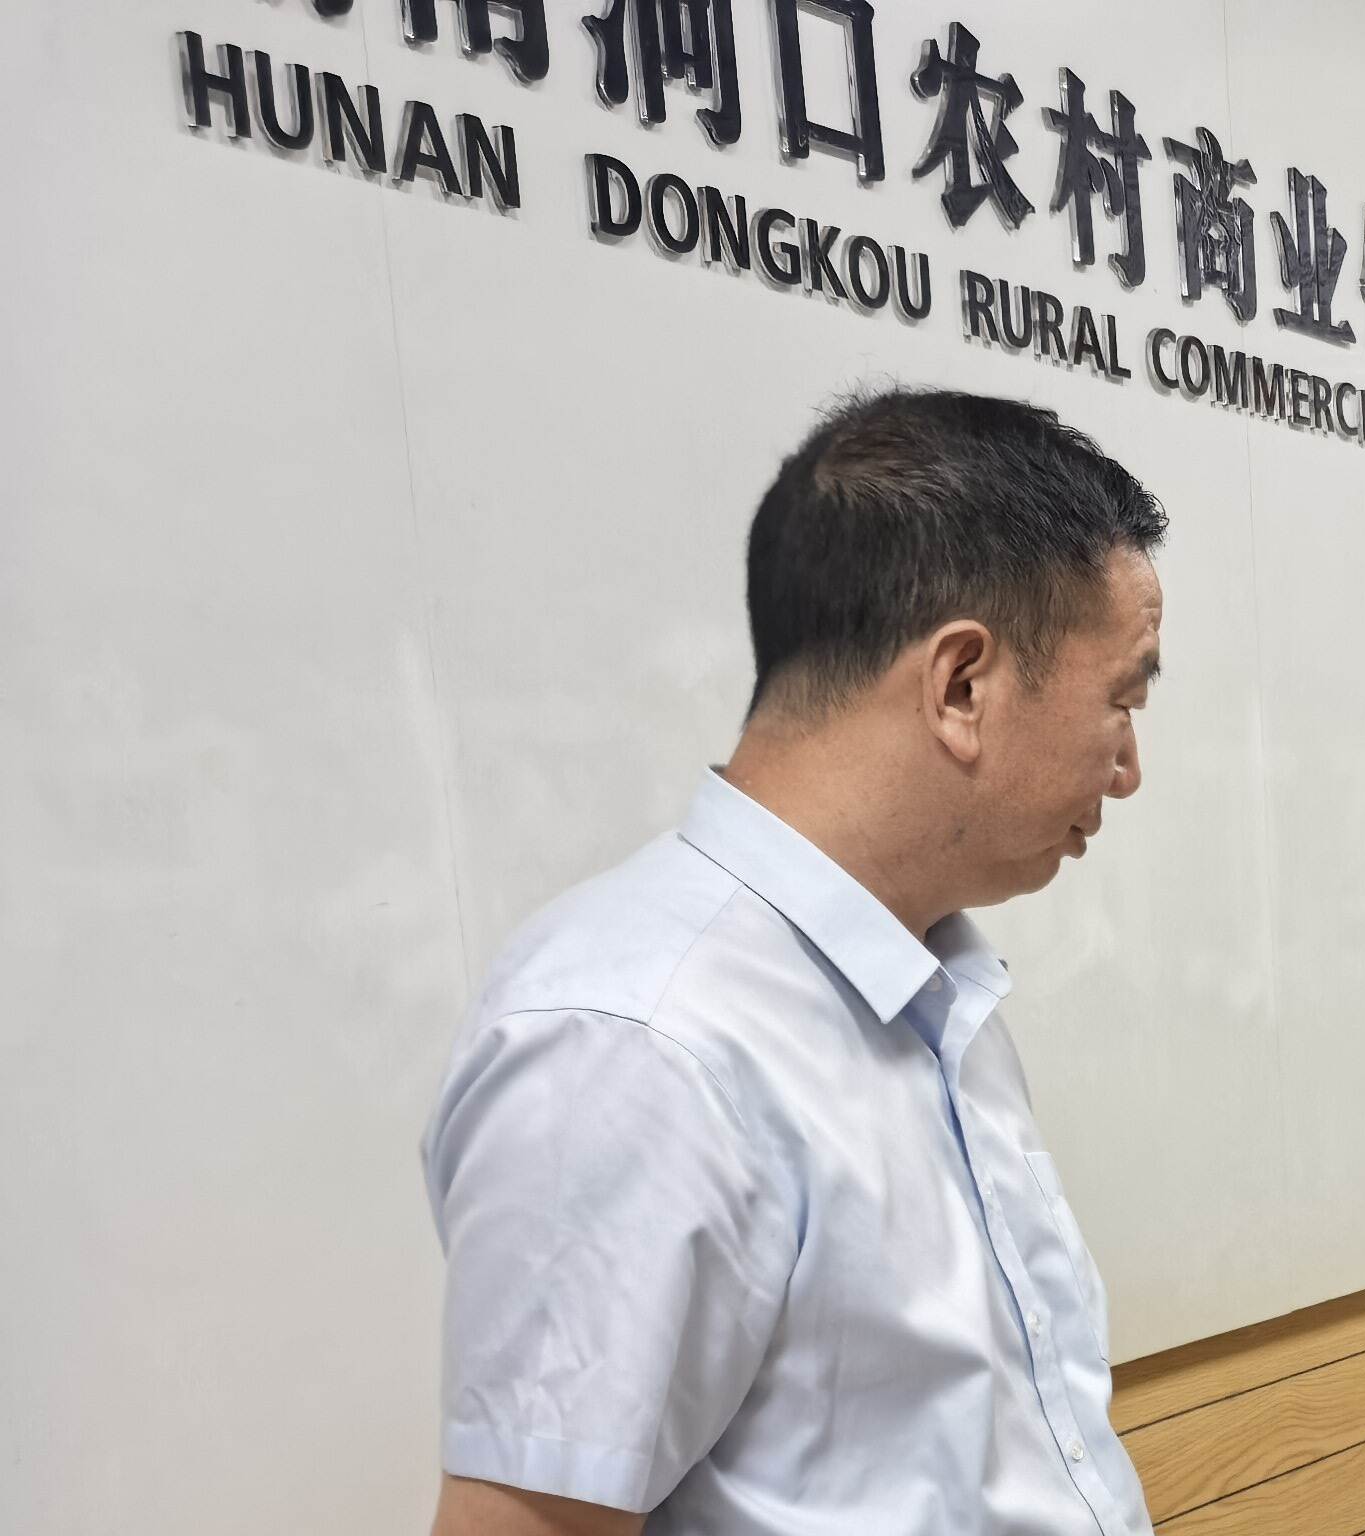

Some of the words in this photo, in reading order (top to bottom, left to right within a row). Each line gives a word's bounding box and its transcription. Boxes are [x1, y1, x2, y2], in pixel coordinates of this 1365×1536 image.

[175, 30, 521, 211] HUNAN
[584, 153, 933, 320] DONGKOU
[959, 269, 1132, 380] RURAL
